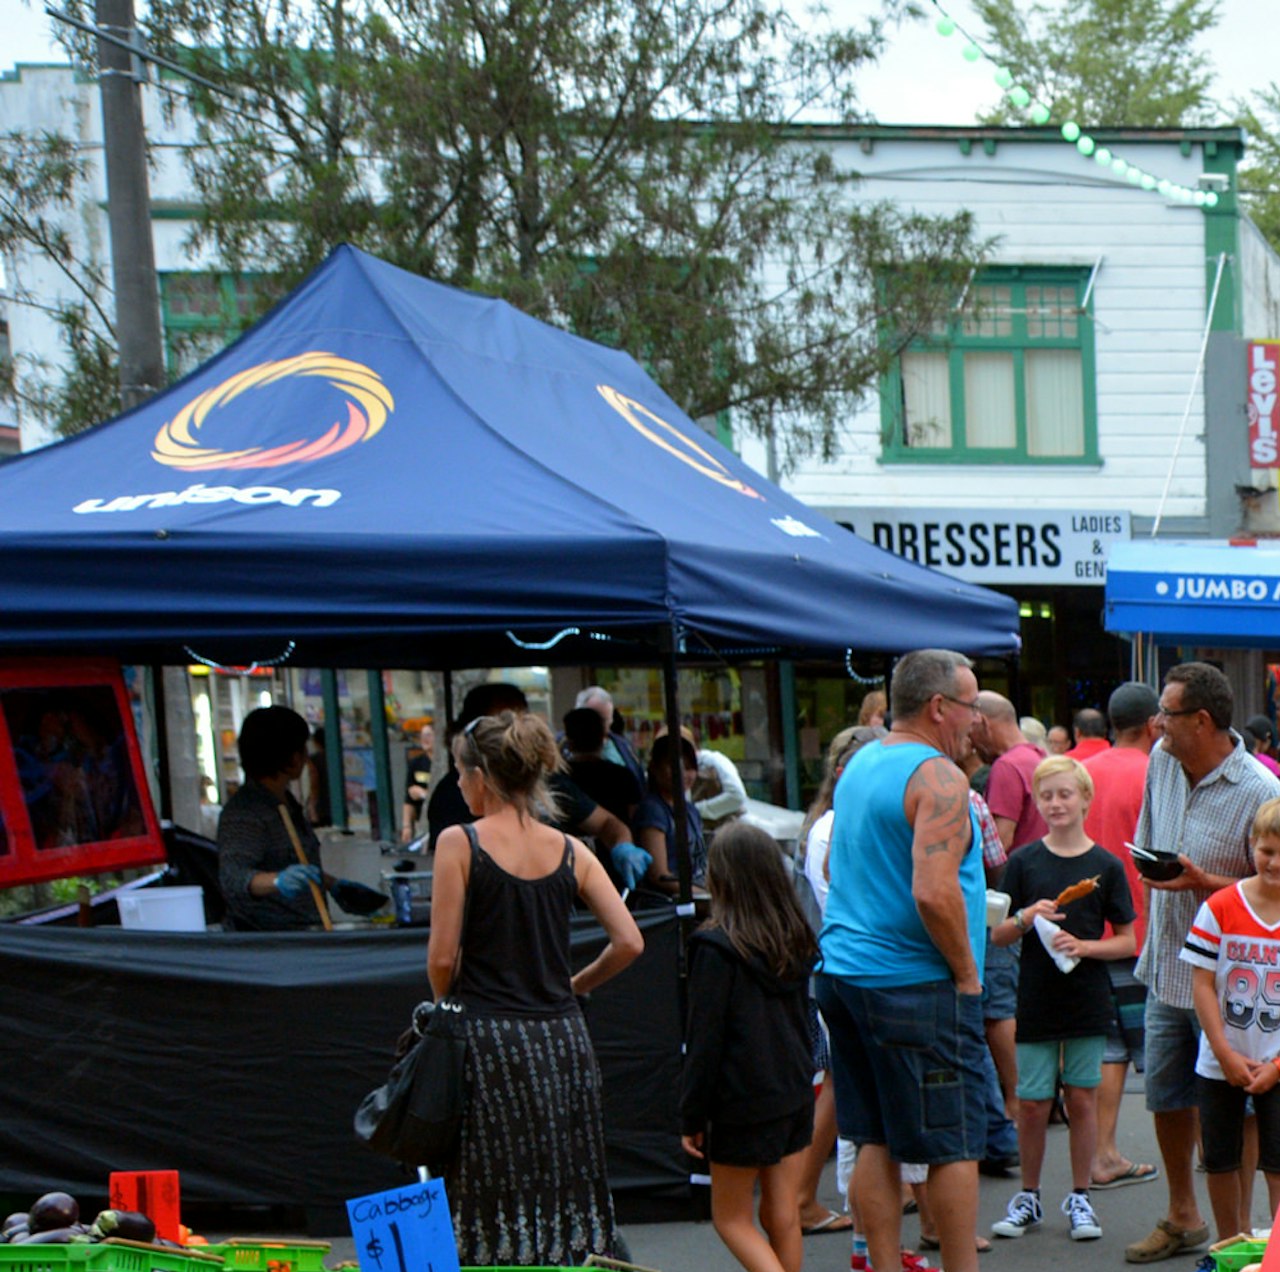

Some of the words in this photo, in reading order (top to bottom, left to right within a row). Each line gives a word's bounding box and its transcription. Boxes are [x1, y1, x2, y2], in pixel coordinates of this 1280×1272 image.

[74, 485, 341, 514] unison
[1072, 516, 1121, 534] LADIES
[1093, 540, 1103, 555] &
[1174, 578, 1267, 600] JUMBO
[352, 1187, 440, 1223] Cabbage
